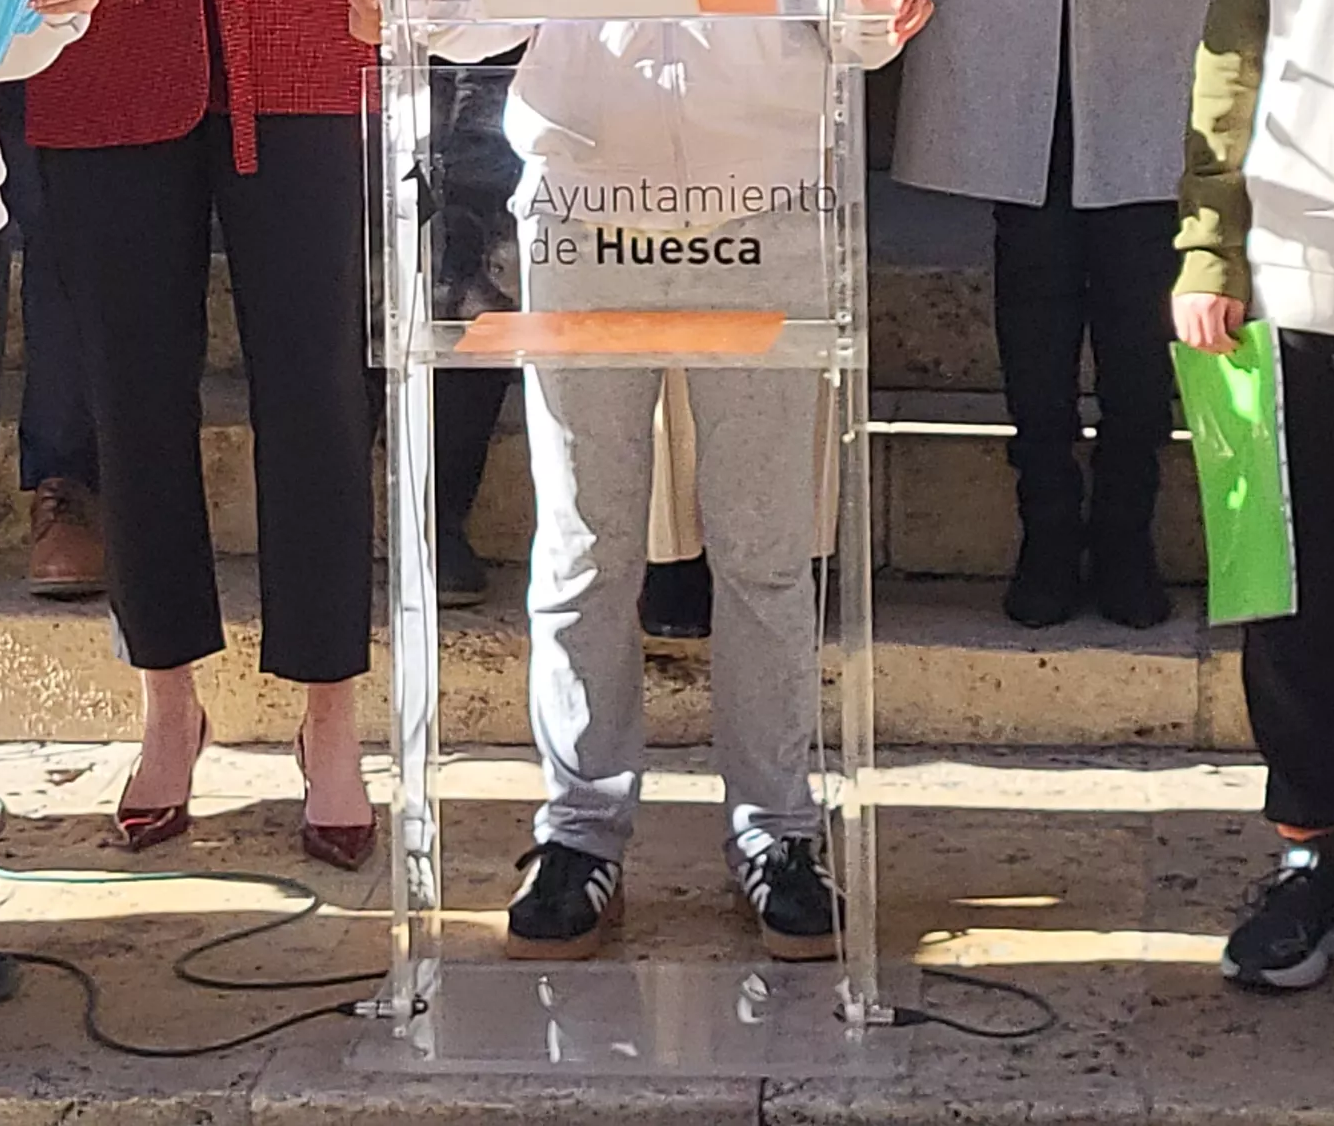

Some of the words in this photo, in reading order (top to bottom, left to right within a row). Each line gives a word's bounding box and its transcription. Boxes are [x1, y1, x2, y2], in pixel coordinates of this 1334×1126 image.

[530, 174, 837, 223] Ayuntamiento
[530, 227, 577, 265] de
[596, 227, 762, 265] Huesca
